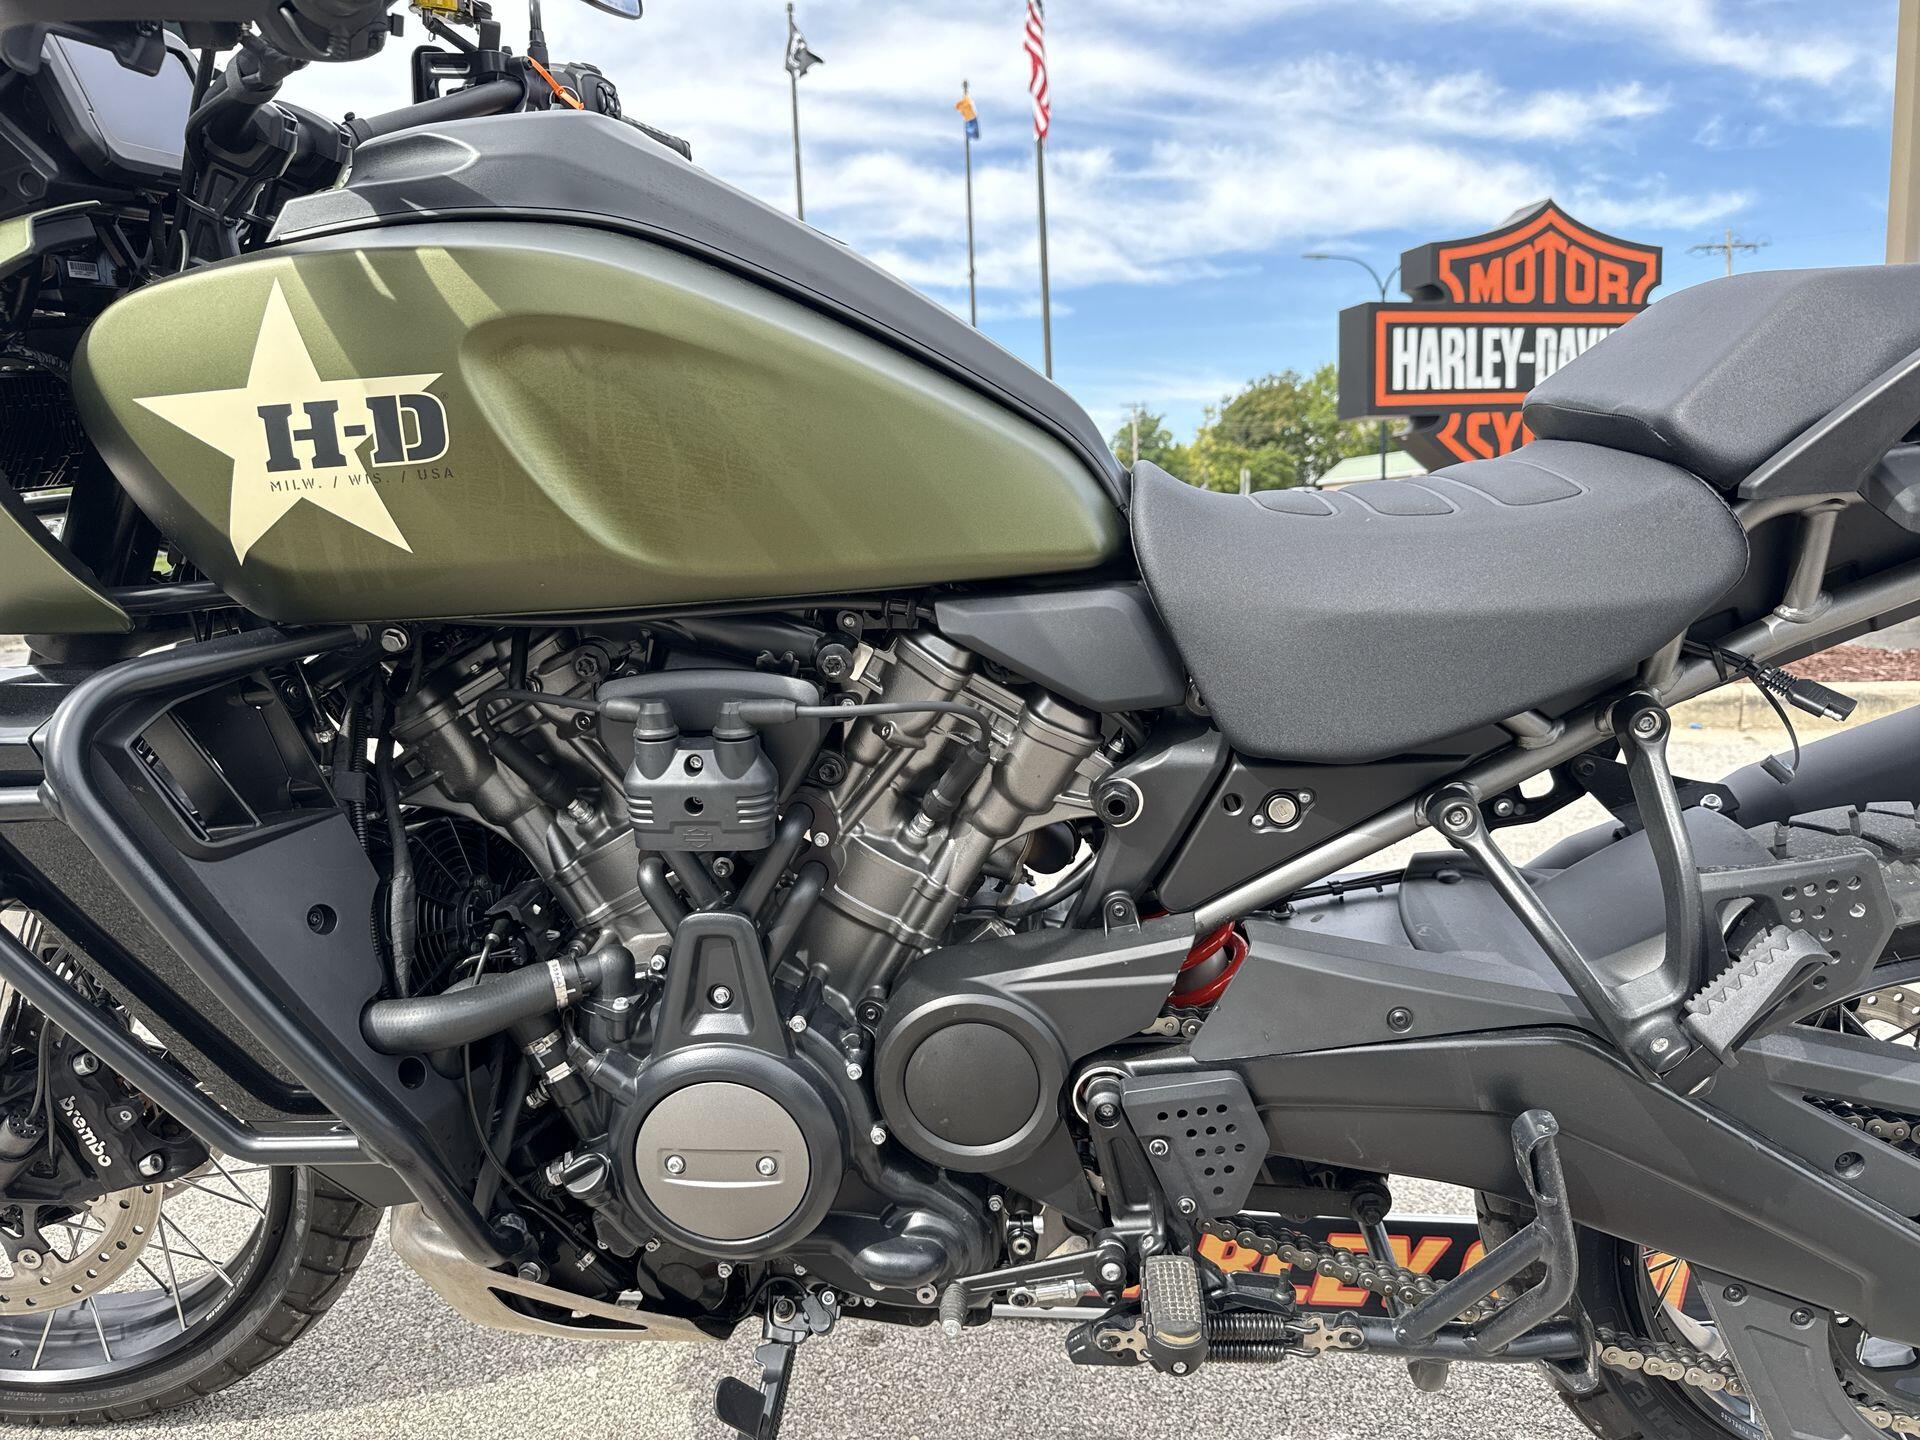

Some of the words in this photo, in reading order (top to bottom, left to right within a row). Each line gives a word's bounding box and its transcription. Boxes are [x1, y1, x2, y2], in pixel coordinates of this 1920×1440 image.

[1469, 230, 1629, 305] MOTOR
[270, 476, 322, 492] MILW.
[348, 472, 390, 487] WIS.
[416, 467, 455, 480] USA
[58, 1095, 112, 1167] brembo
